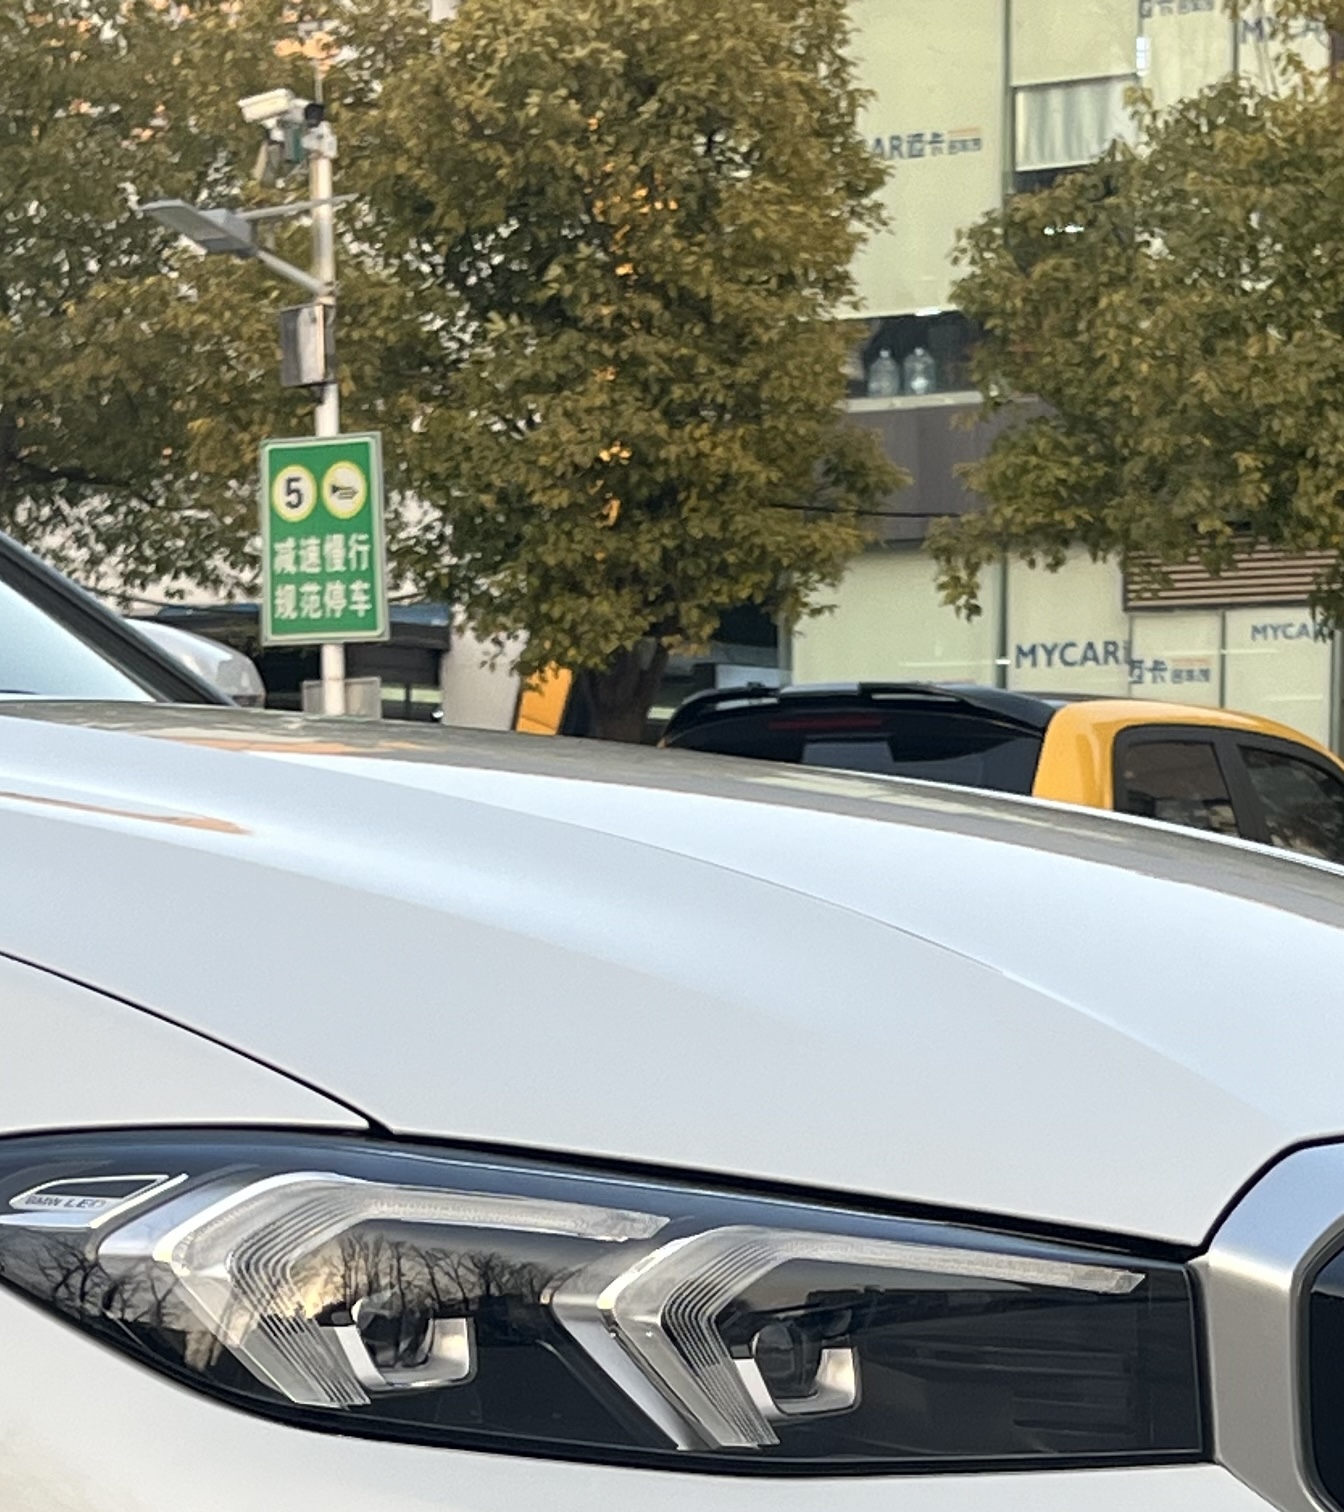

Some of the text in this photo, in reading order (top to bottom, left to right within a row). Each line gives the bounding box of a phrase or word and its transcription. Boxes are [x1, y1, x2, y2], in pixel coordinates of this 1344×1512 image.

[285, 477, 303, 509] 5
[273, 533, 371, 575] 减速慢行
[273, 580, 373, 620] 规范停车
